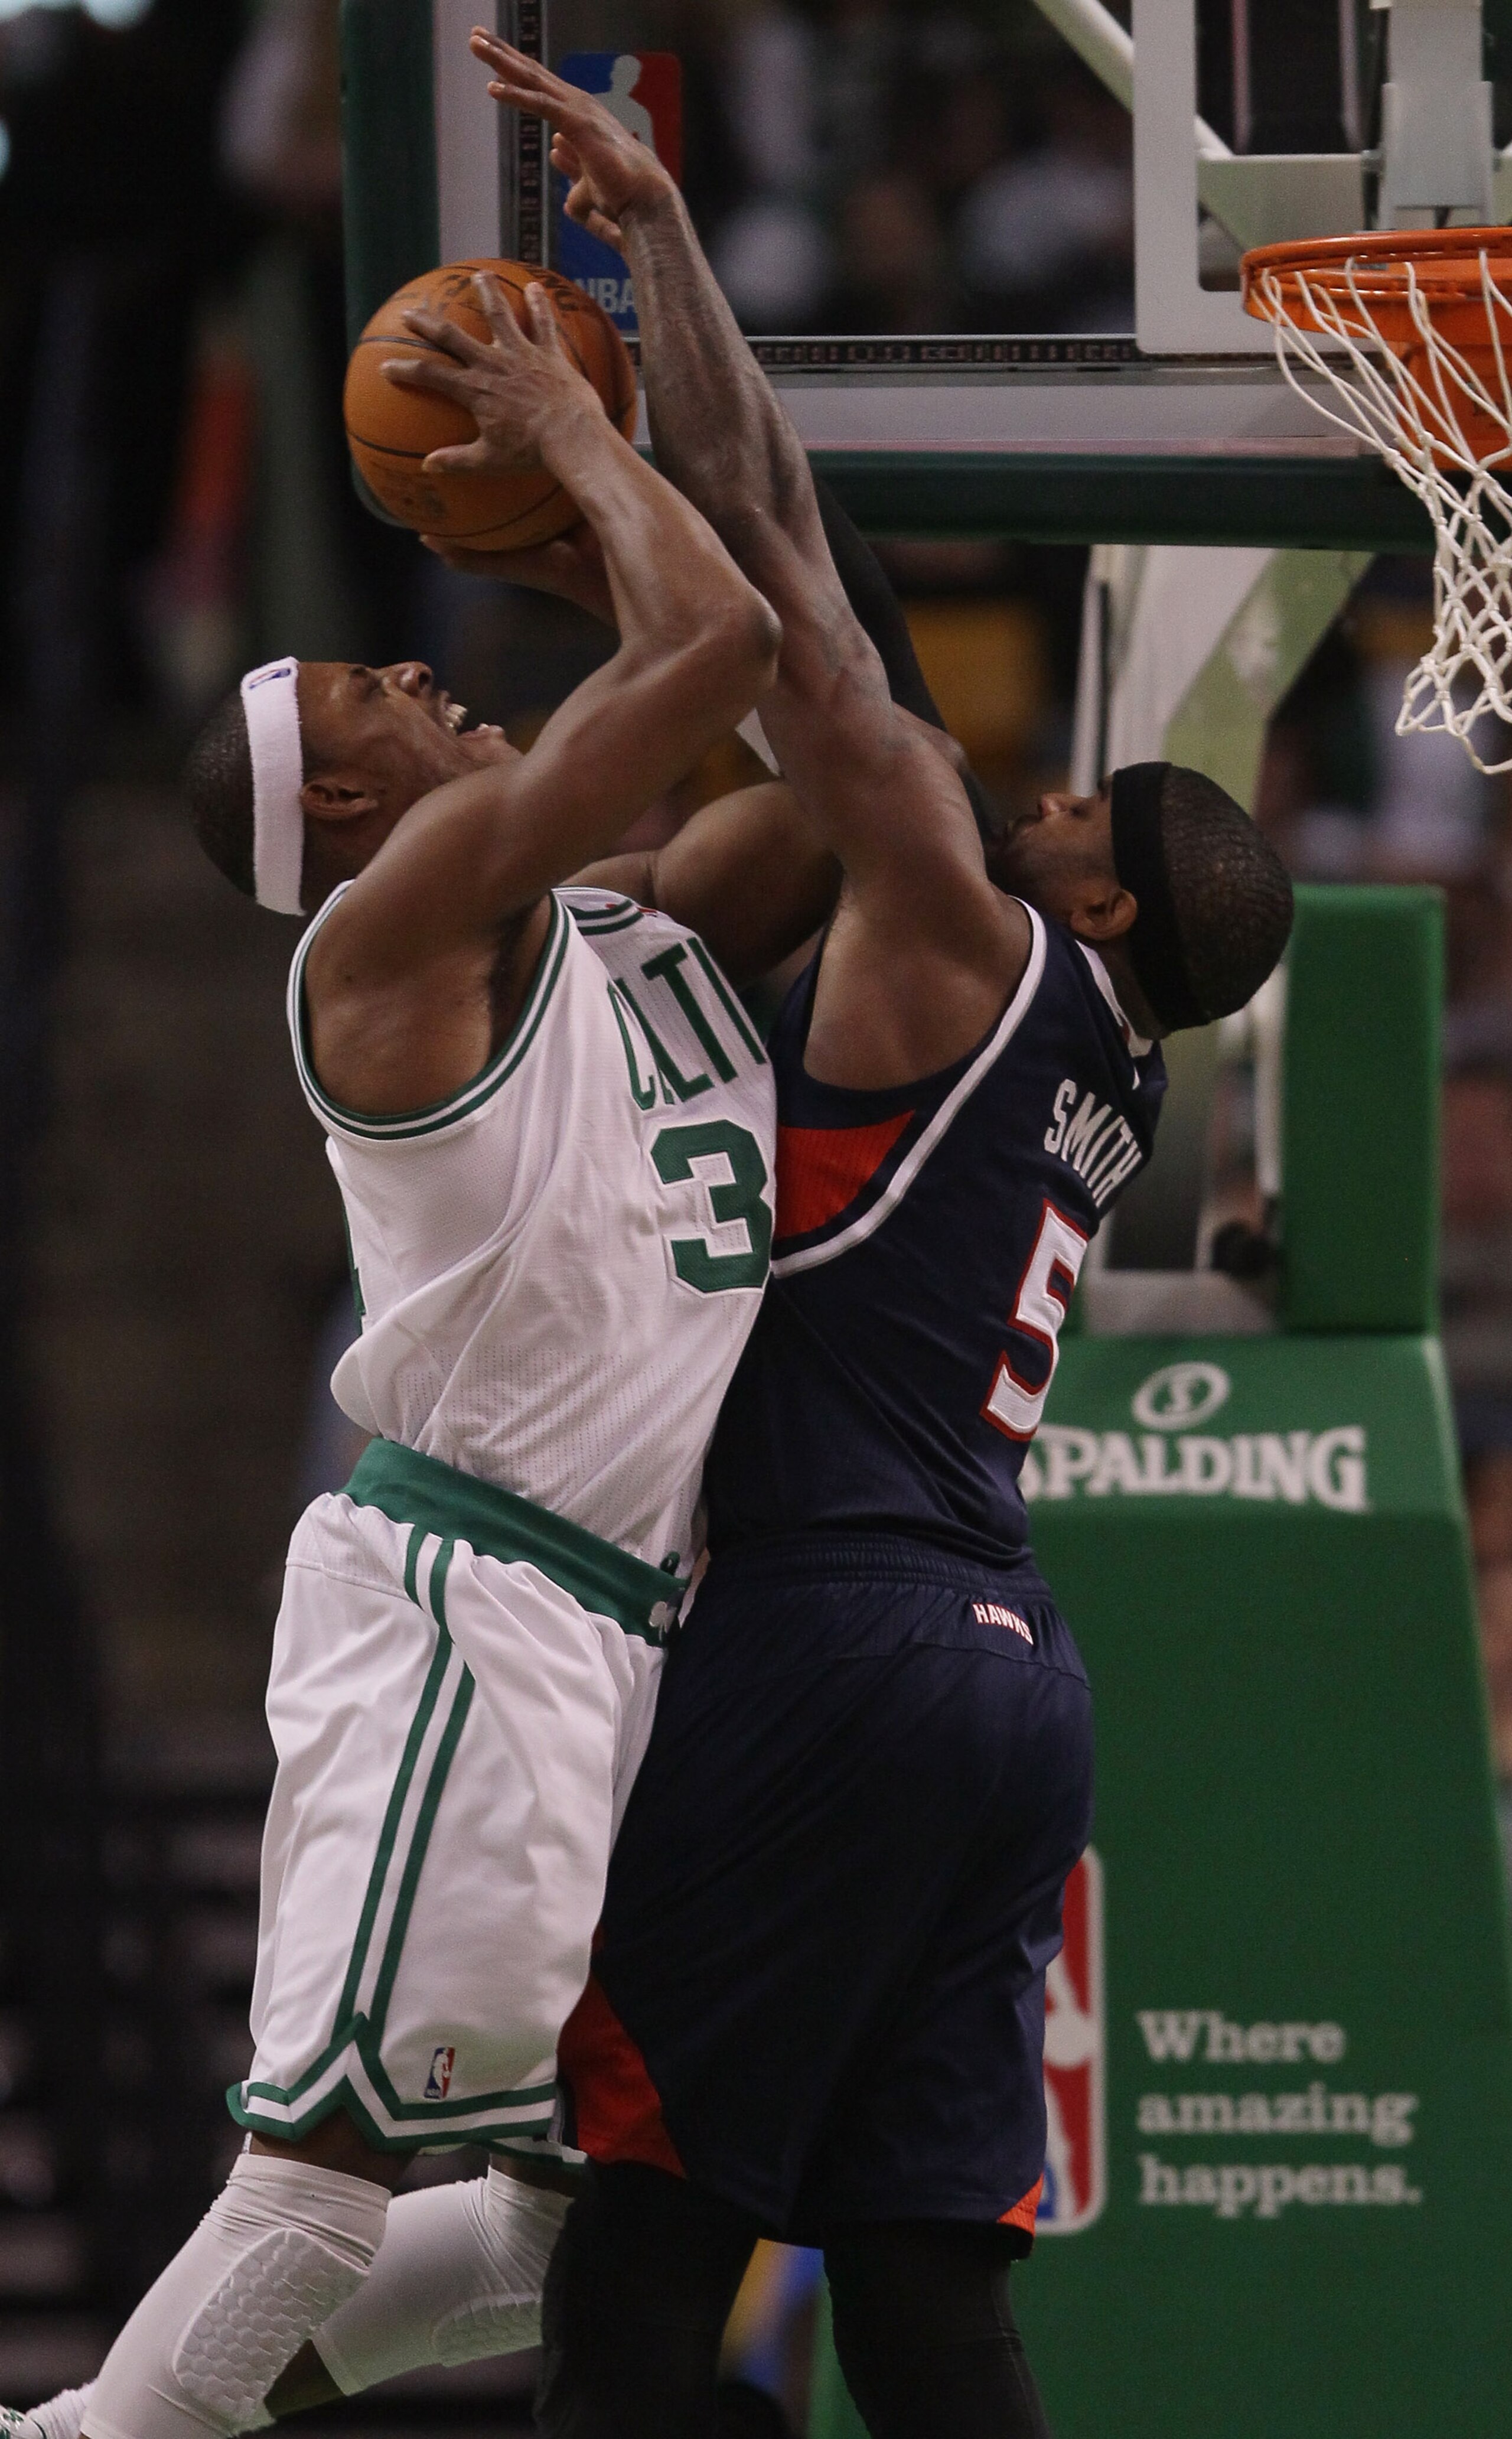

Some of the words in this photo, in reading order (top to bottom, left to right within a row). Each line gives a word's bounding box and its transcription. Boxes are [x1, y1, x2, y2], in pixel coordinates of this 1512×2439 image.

[1044, 1078, 1142, 1208] SMITH
[979, 1198, 1089, 1443] 5
[972, 1603, 1034, 1646] HAWKS
[1136, 2008, 1345, 2064] Where
[1138, 2082, 1419, 2147] amazing
[1138, 2153, 1423, 2219] happens.
